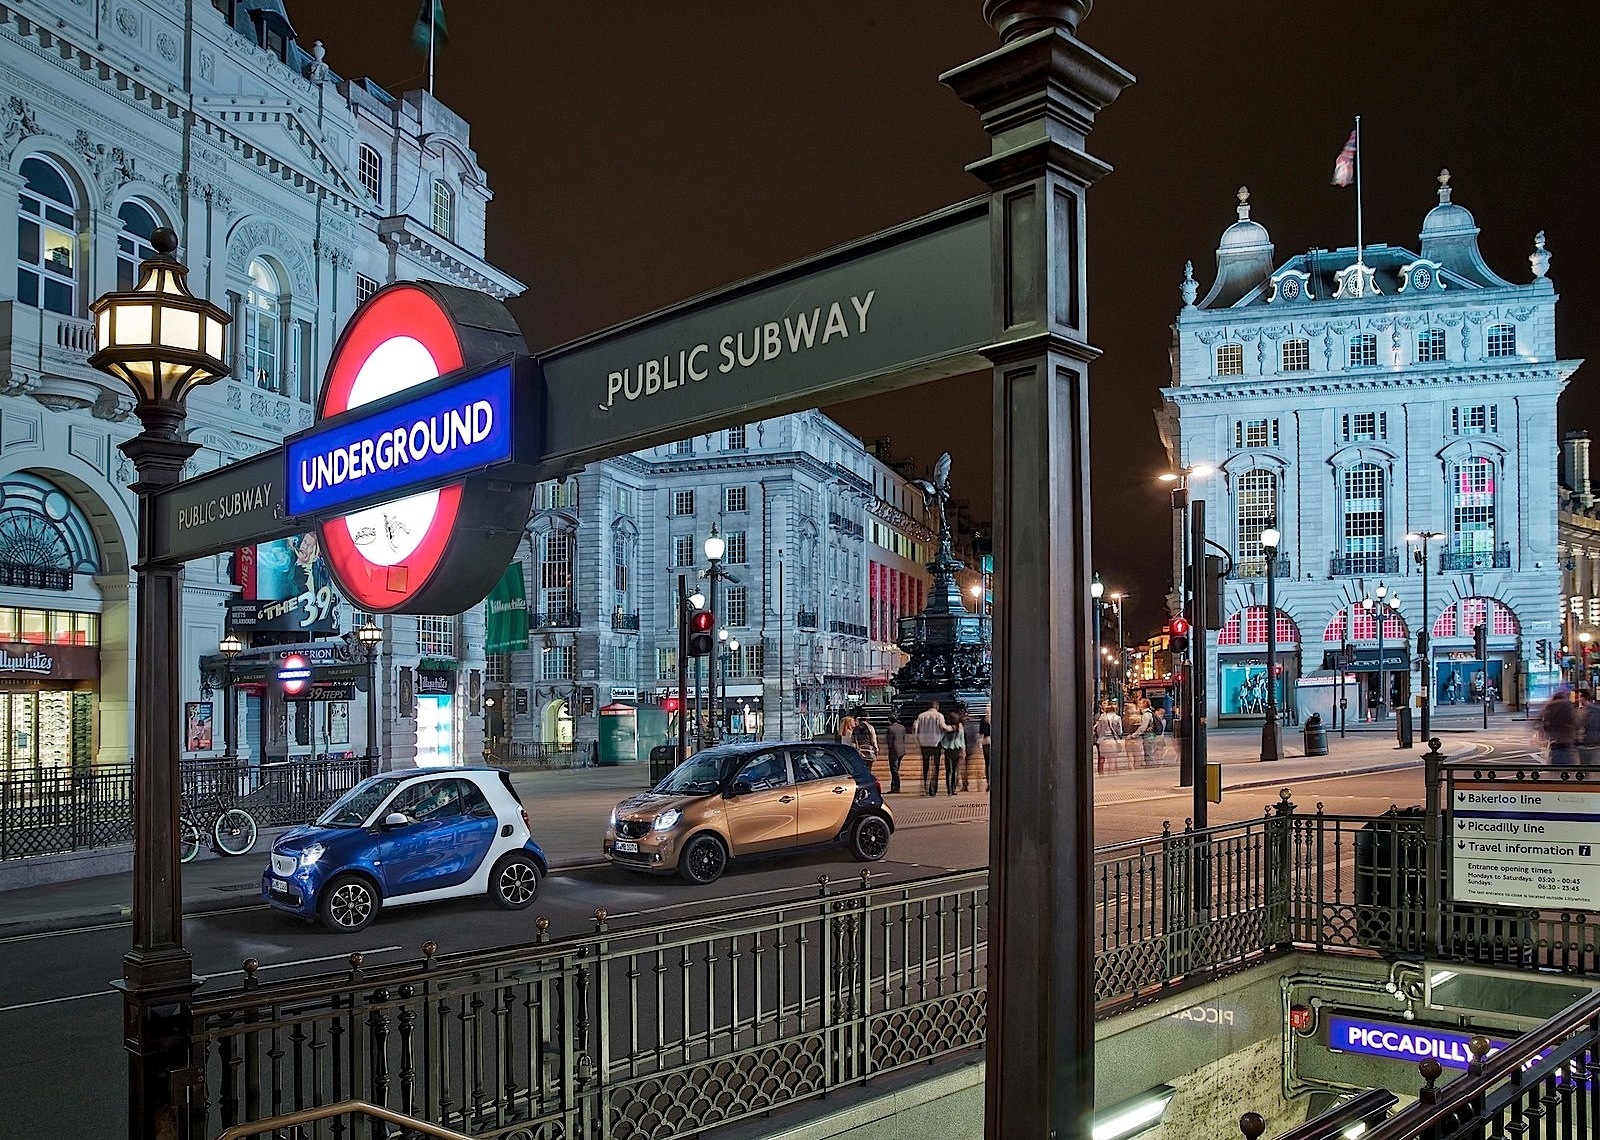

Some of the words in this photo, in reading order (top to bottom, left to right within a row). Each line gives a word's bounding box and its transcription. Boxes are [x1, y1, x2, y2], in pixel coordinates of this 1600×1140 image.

[606, 344, 709, 406] PUBLIC
[718, 290, 876, 373] SUBWAY
[301, 400, 493, 493] UNDERGROUND
[178, 499, 216, 530] PUBLIC
[218, 482, 273, 518] SUBWAY
[241, 564, 249, 590] THE
[1468, 793, 1517, 804] Bakerloo
[1520, 794, 1542, 804] line
[1468, 822, 1520, 834] Piccadilly
[1523, 823, 1545, 834] line
[1469, 842, 1502, 852] Travel
[1505, 844, 1574, 855] information
[1468, 863, 1498, 871] Entrance
[1500, 866, 1529, 874] opening
[1348, 1026, 1474, 1063] PICCADILLY
